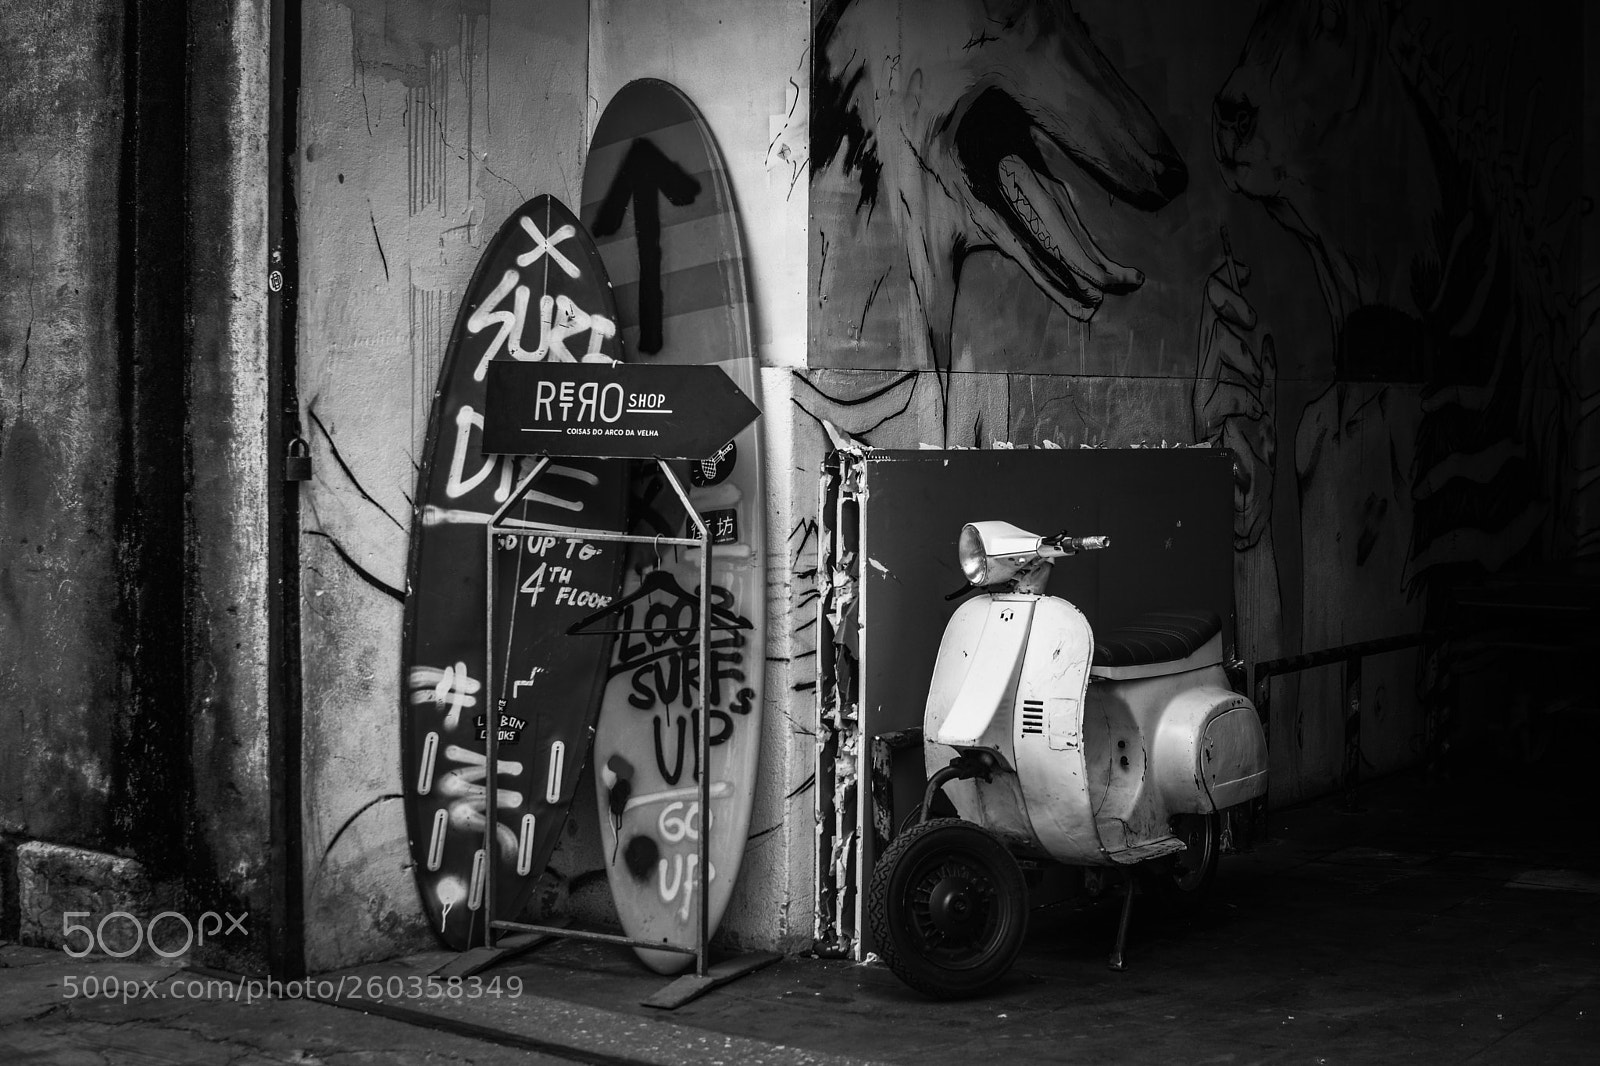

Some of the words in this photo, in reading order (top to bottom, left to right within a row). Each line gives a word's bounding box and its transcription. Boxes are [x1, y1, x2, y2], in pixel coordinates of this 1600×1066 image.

[628, 393, 666, 408] SHOP
[566, 427, 591, 436] COISAS
[592, 428, 603, 436] DO
[604, 428, 624, 436] ARCO
[637, 429, 659, 437] VELHA
[527, 535, 557, 557] UP
[520, 561, 573, 607] 4TH
[477, 714, 526, 730] LBON
[653, 708, 734, 786] UP
